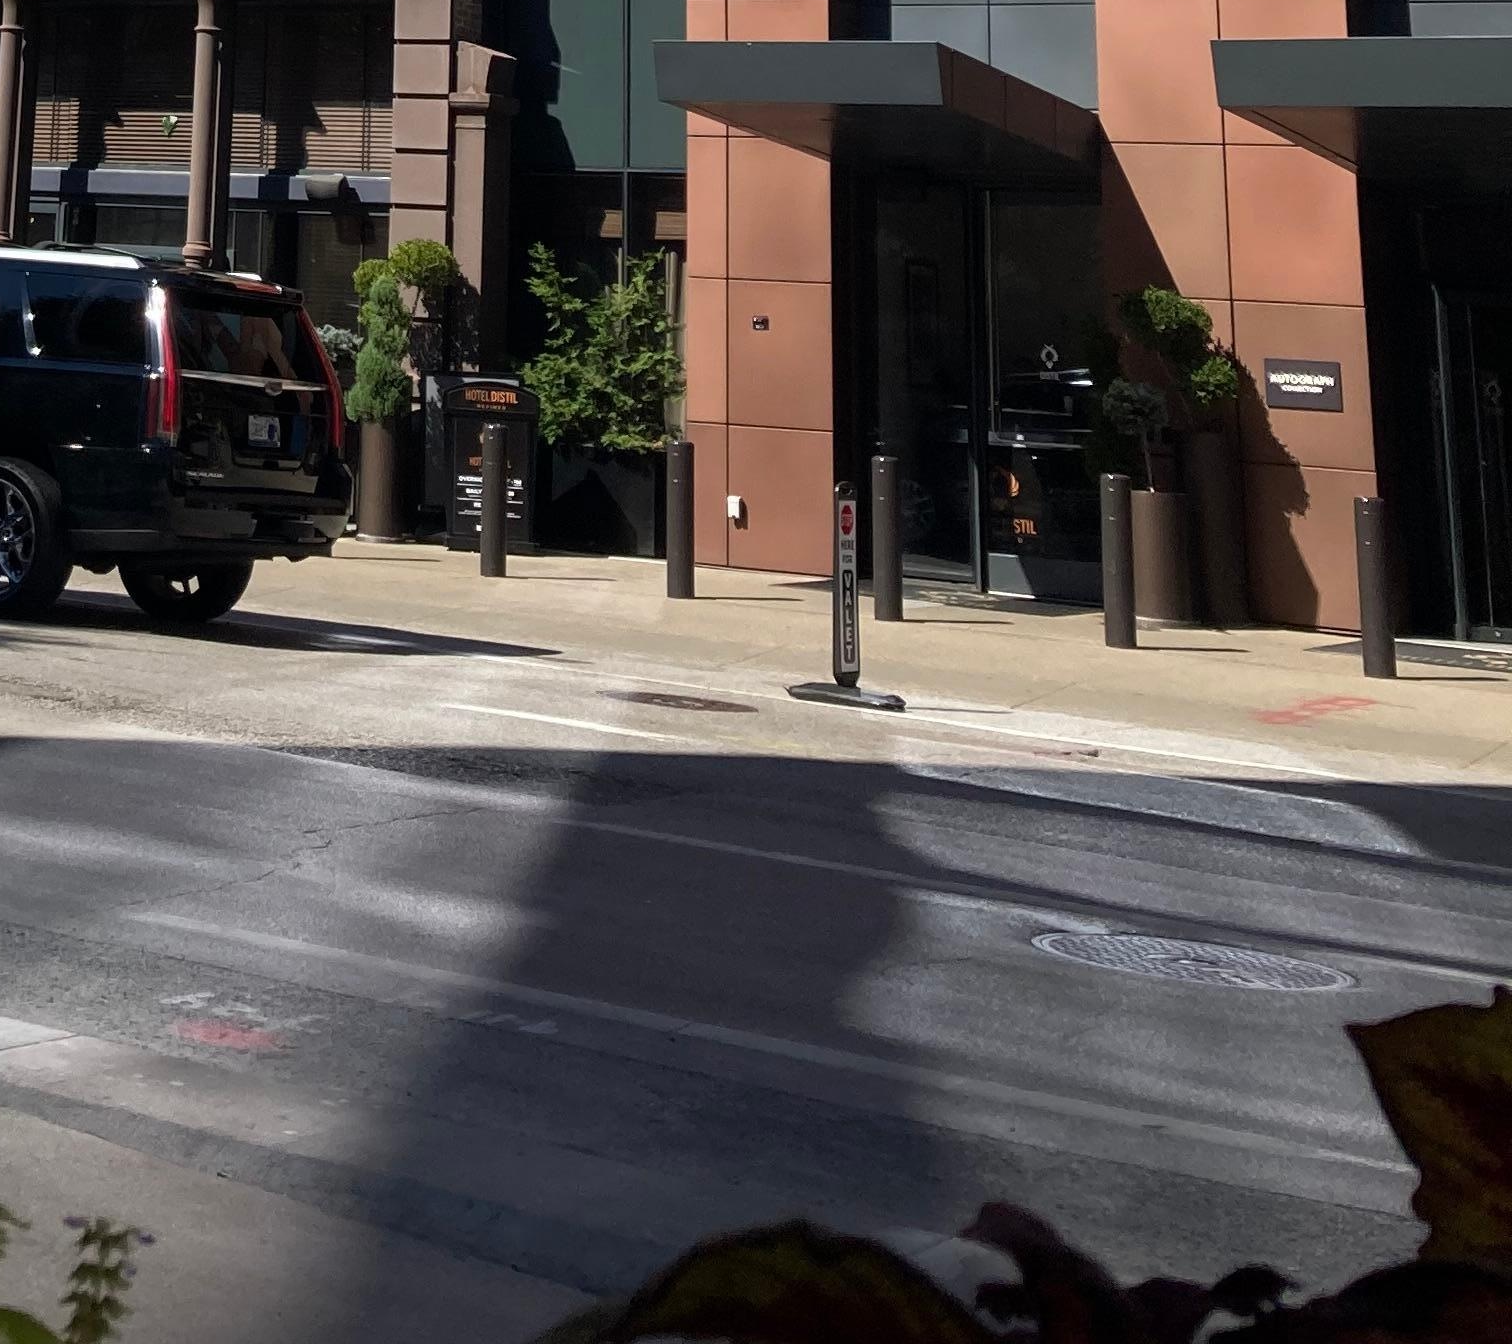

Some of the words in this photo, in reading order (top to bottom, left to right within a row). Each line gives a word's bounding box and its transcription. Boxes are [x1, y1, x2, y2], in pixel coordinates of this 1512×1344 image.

[465, 389, 490, 402] HOTEL
[490, 391, 518, 404] DISTIL
[843, 572, 854, 661] VALET
